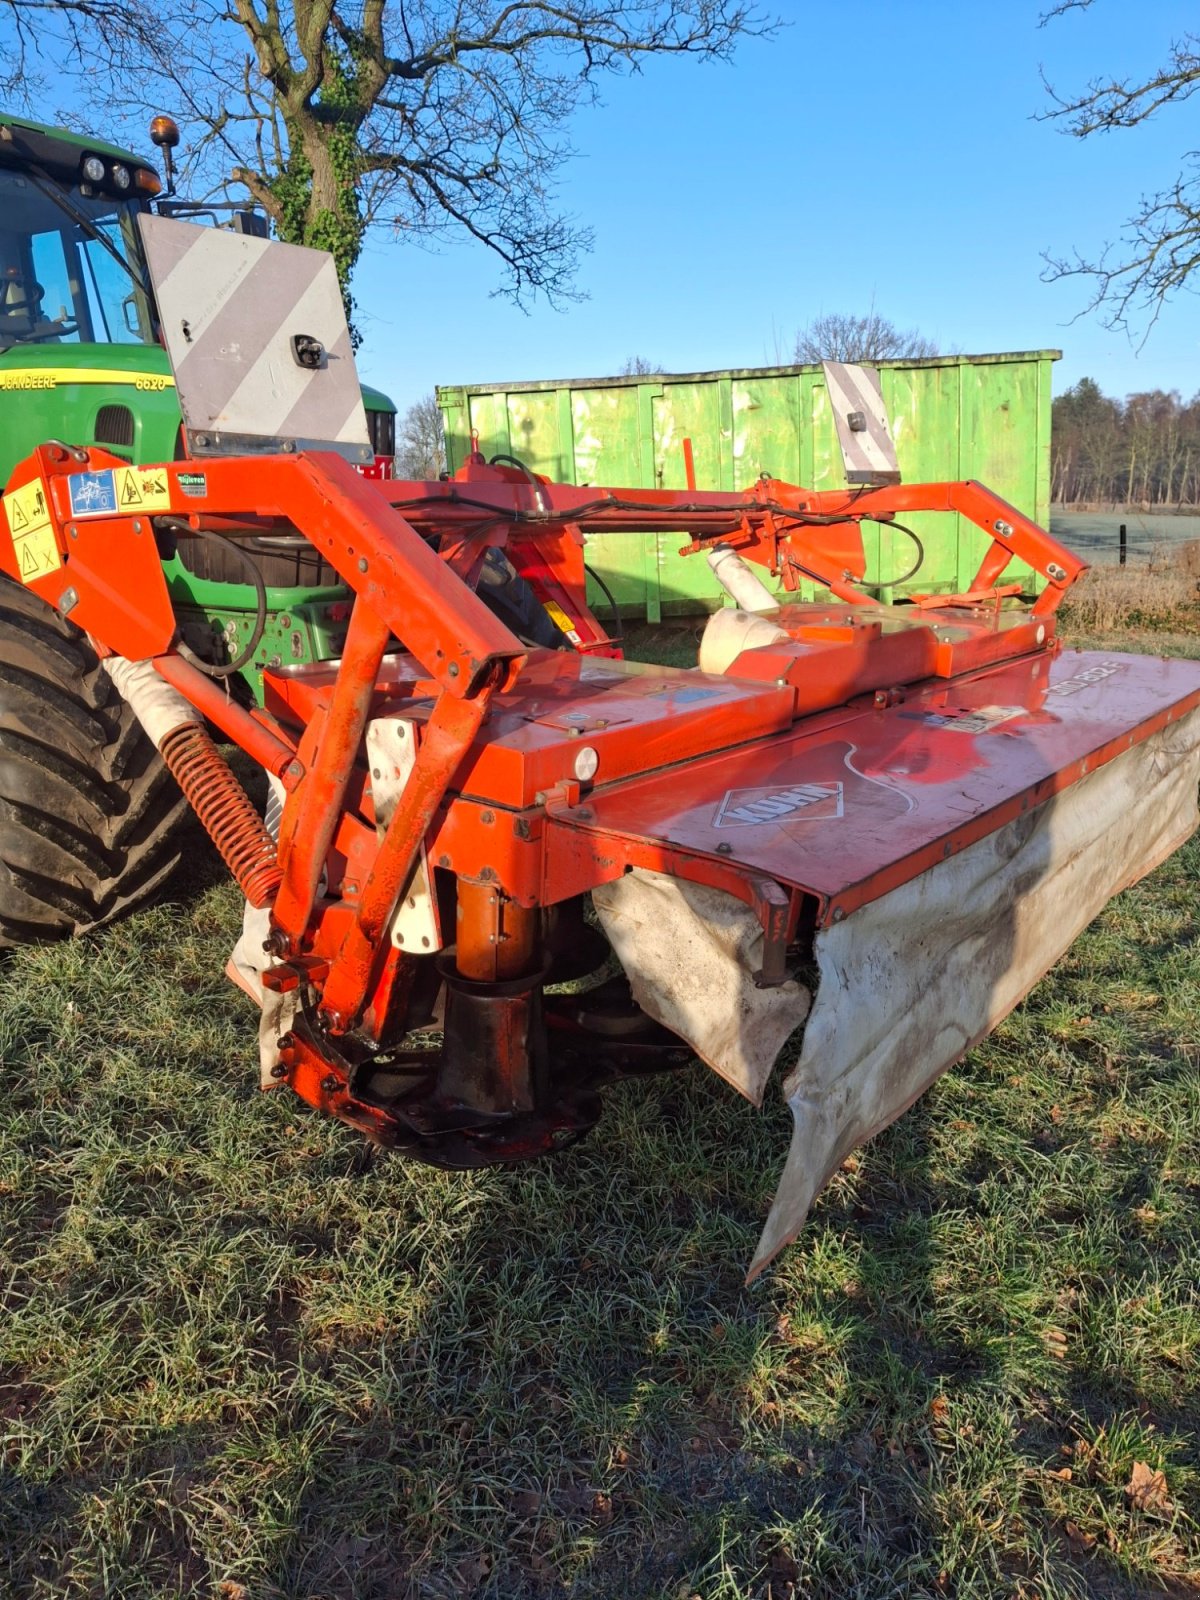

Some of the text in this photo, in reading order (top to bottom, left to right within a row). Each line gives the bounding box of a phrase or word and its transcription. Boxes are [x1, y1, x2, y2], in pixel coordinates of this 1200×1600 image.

[135, 376, 166, 391] 6620
[1072, 666, 1118, 682] 802
[720, 784, 842, 823] KUHN
